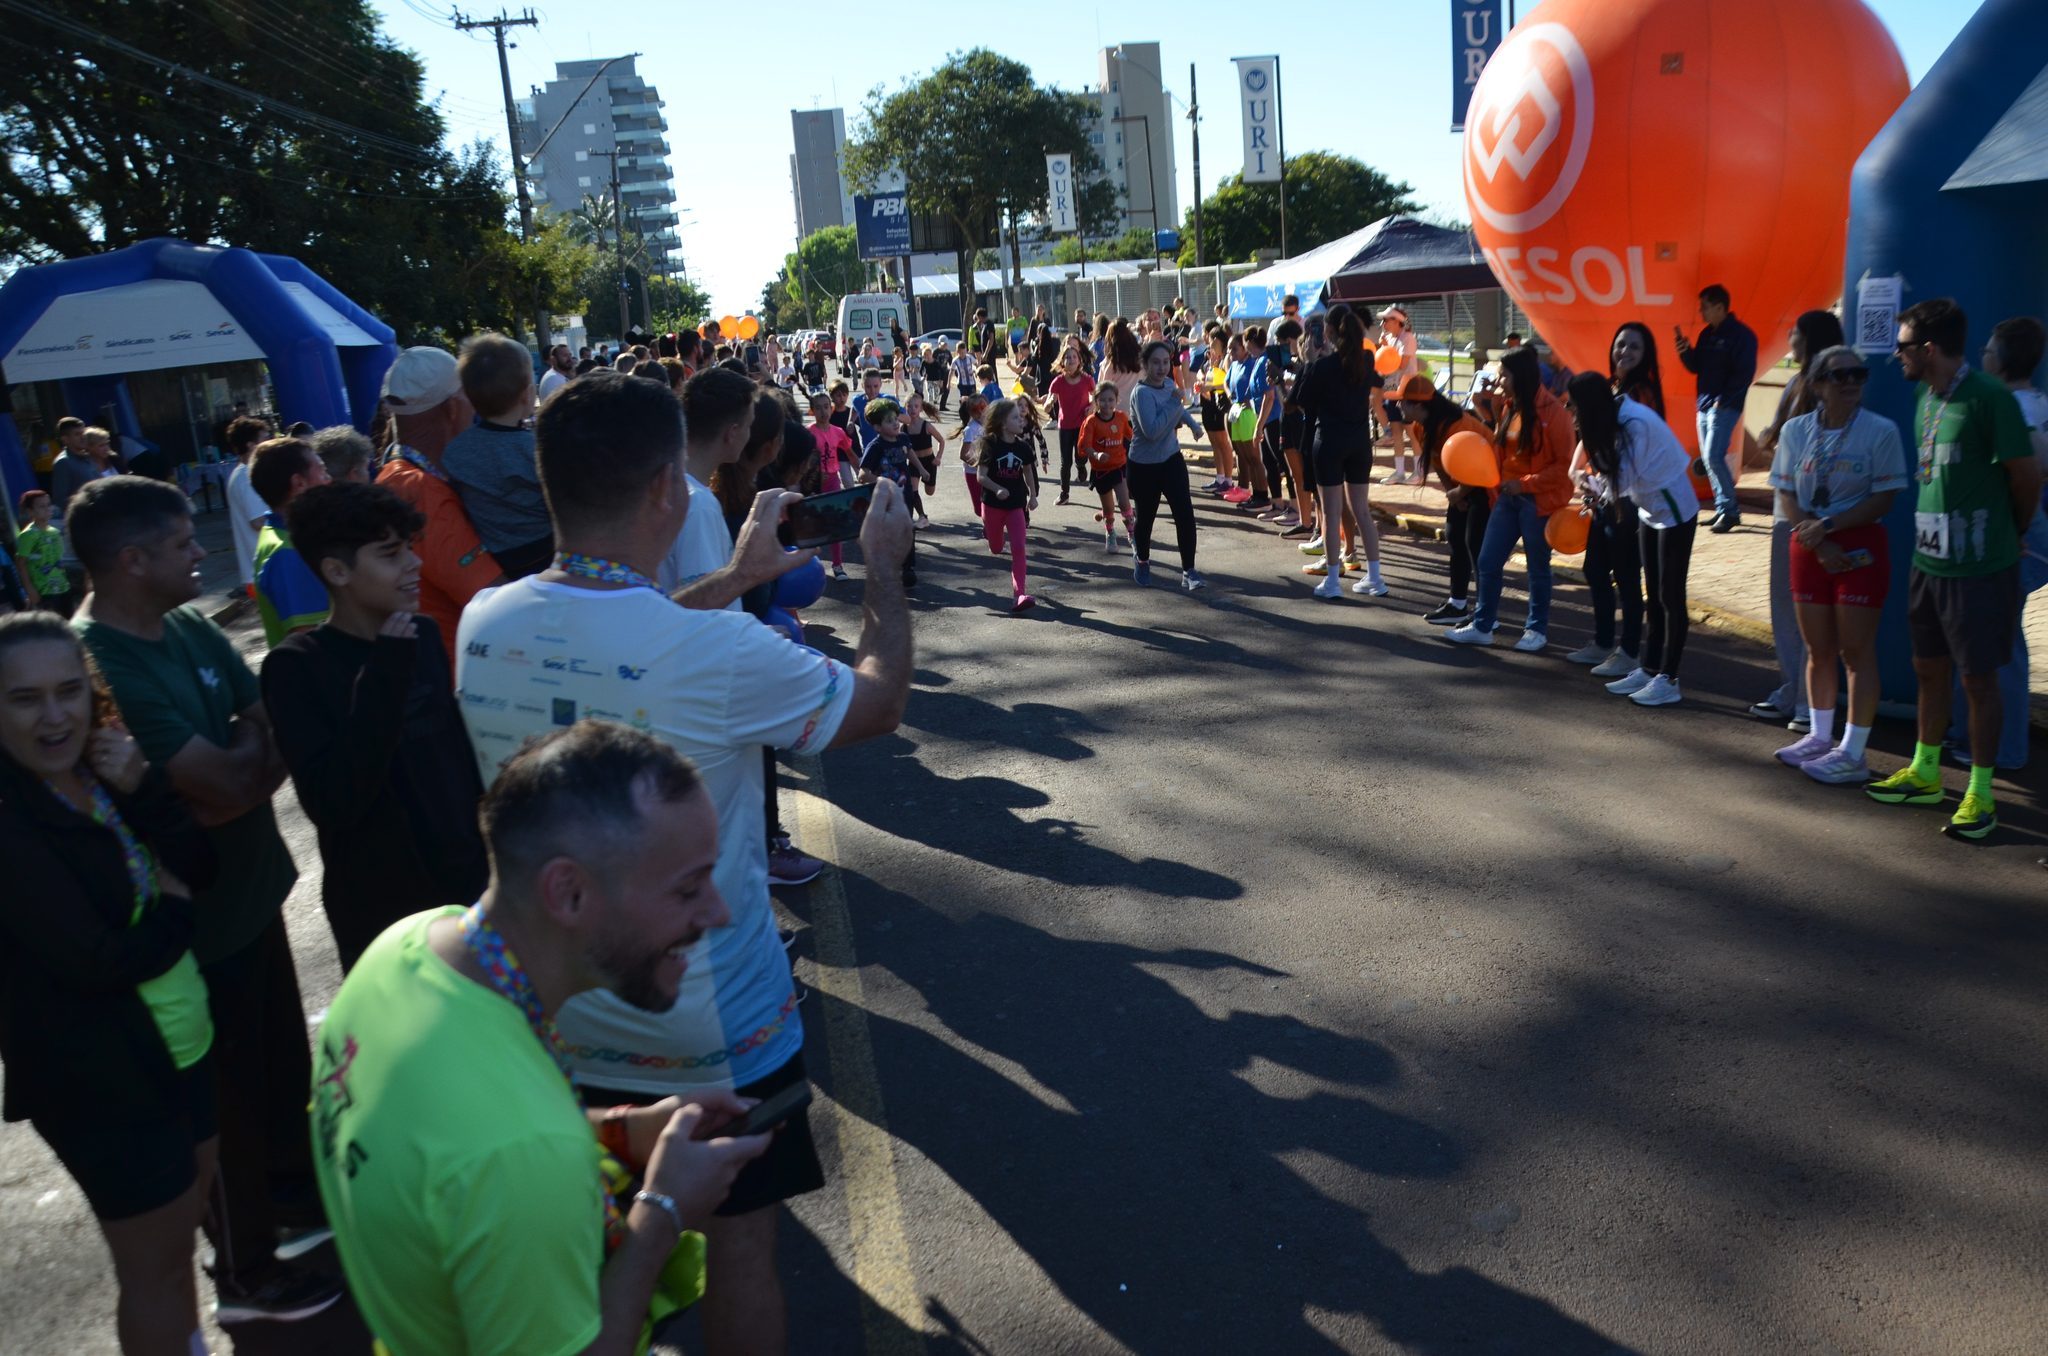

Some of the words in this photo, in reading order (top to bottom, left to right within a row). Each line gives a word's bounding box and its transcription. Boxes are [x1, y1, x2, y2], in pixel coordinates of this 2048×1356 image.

[1462, 10, 1492, 91] UR
[1248, 100, 1270, 174] URI
[1055, 180, 1067, 225] URI
[105, 337, 155, 348] Sindicatos
